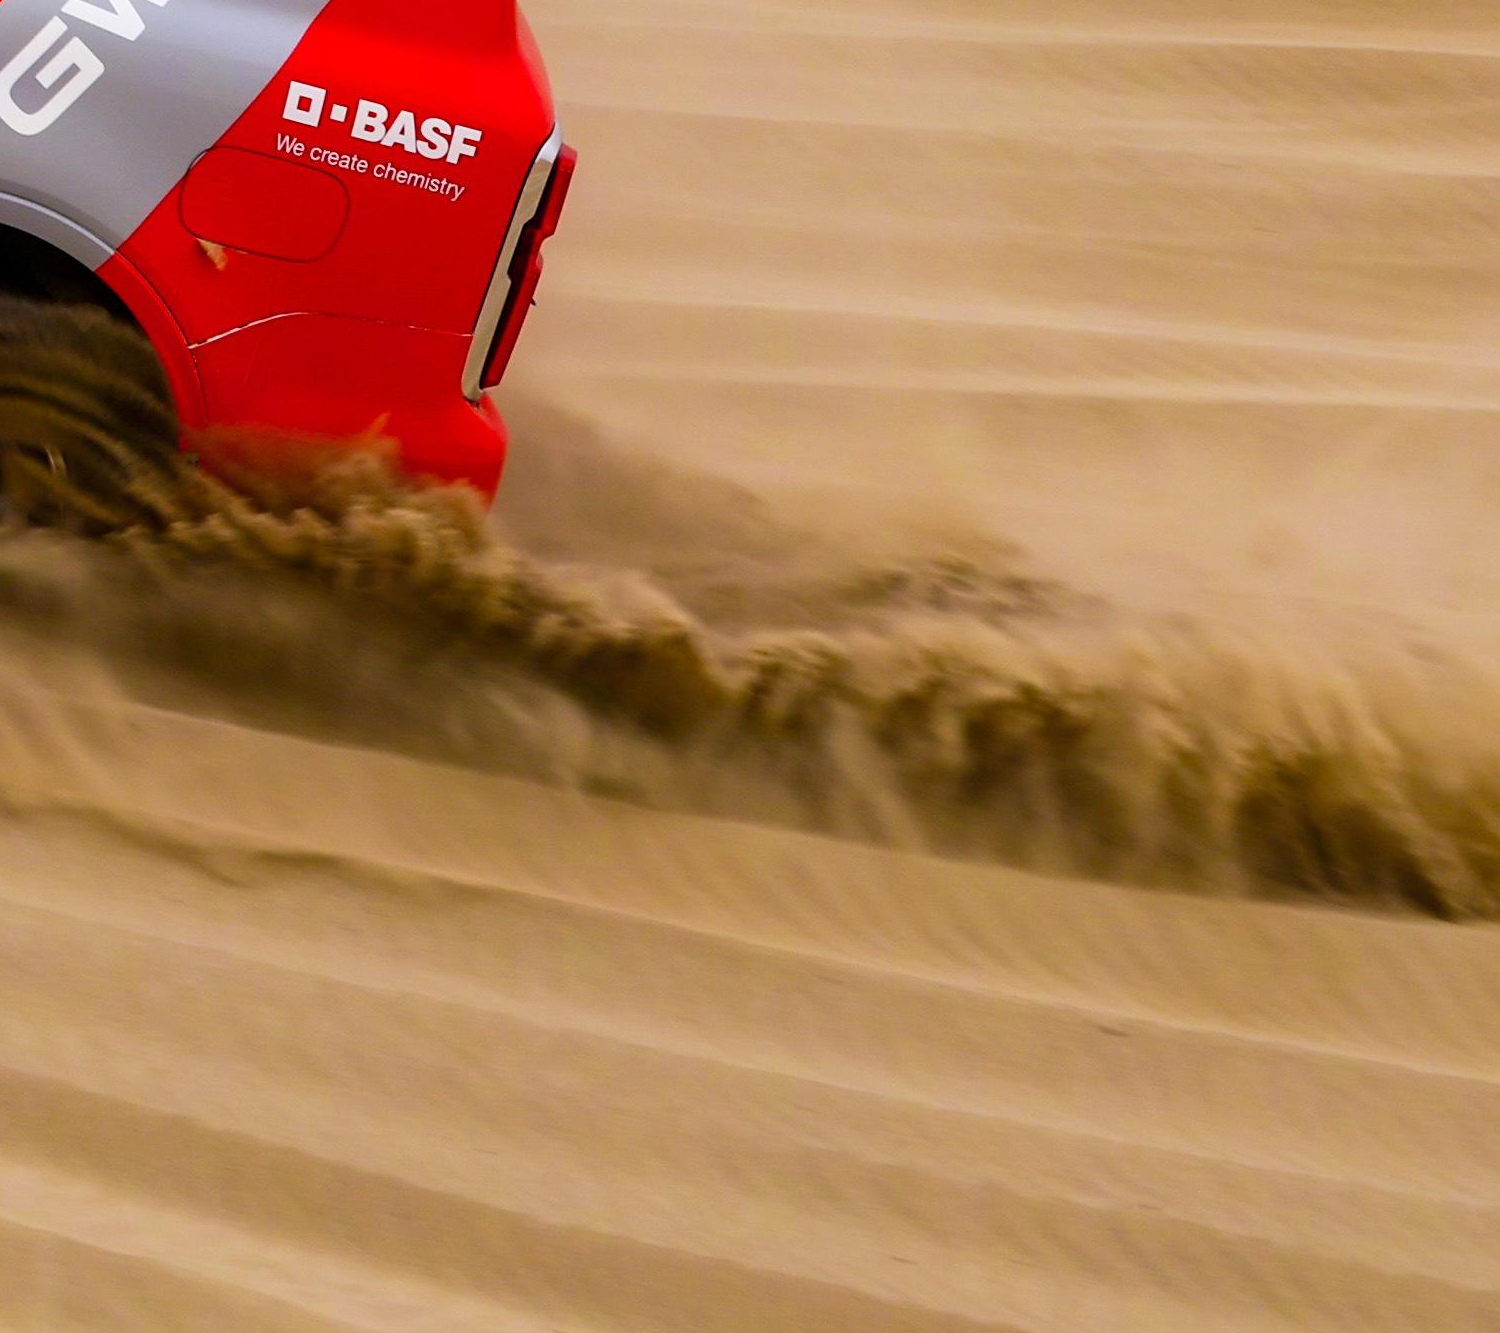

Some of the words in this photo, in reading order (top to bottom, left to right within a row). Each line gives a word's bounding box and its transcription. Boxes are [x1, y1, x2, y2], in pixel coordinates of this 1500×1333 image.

[351, 99, 483, 164] BASF
[276, 133, 305, 156] We
[309, 146, 368, 173] create
[373, 162, 465, 201] chemistry
